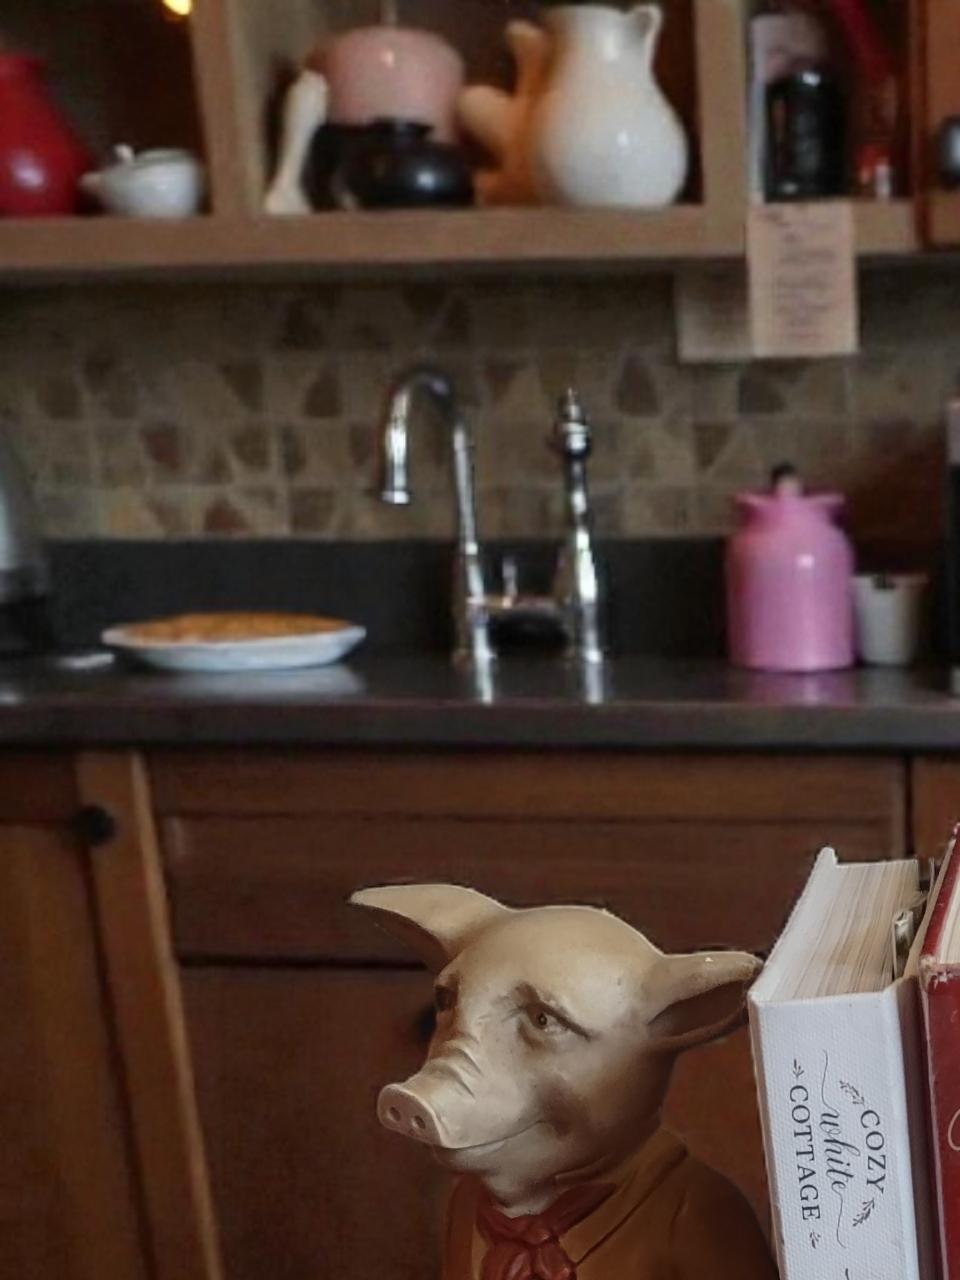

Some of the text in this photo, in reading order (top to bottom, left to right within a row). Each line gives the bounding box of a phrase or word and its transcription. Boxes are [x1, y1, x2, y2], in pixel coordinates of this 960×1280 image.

[788, 1084, 822, 1222] COTTAGE
[820, 1100, 861, 1205] white
[860, 1109, 887, 1195] COZY
